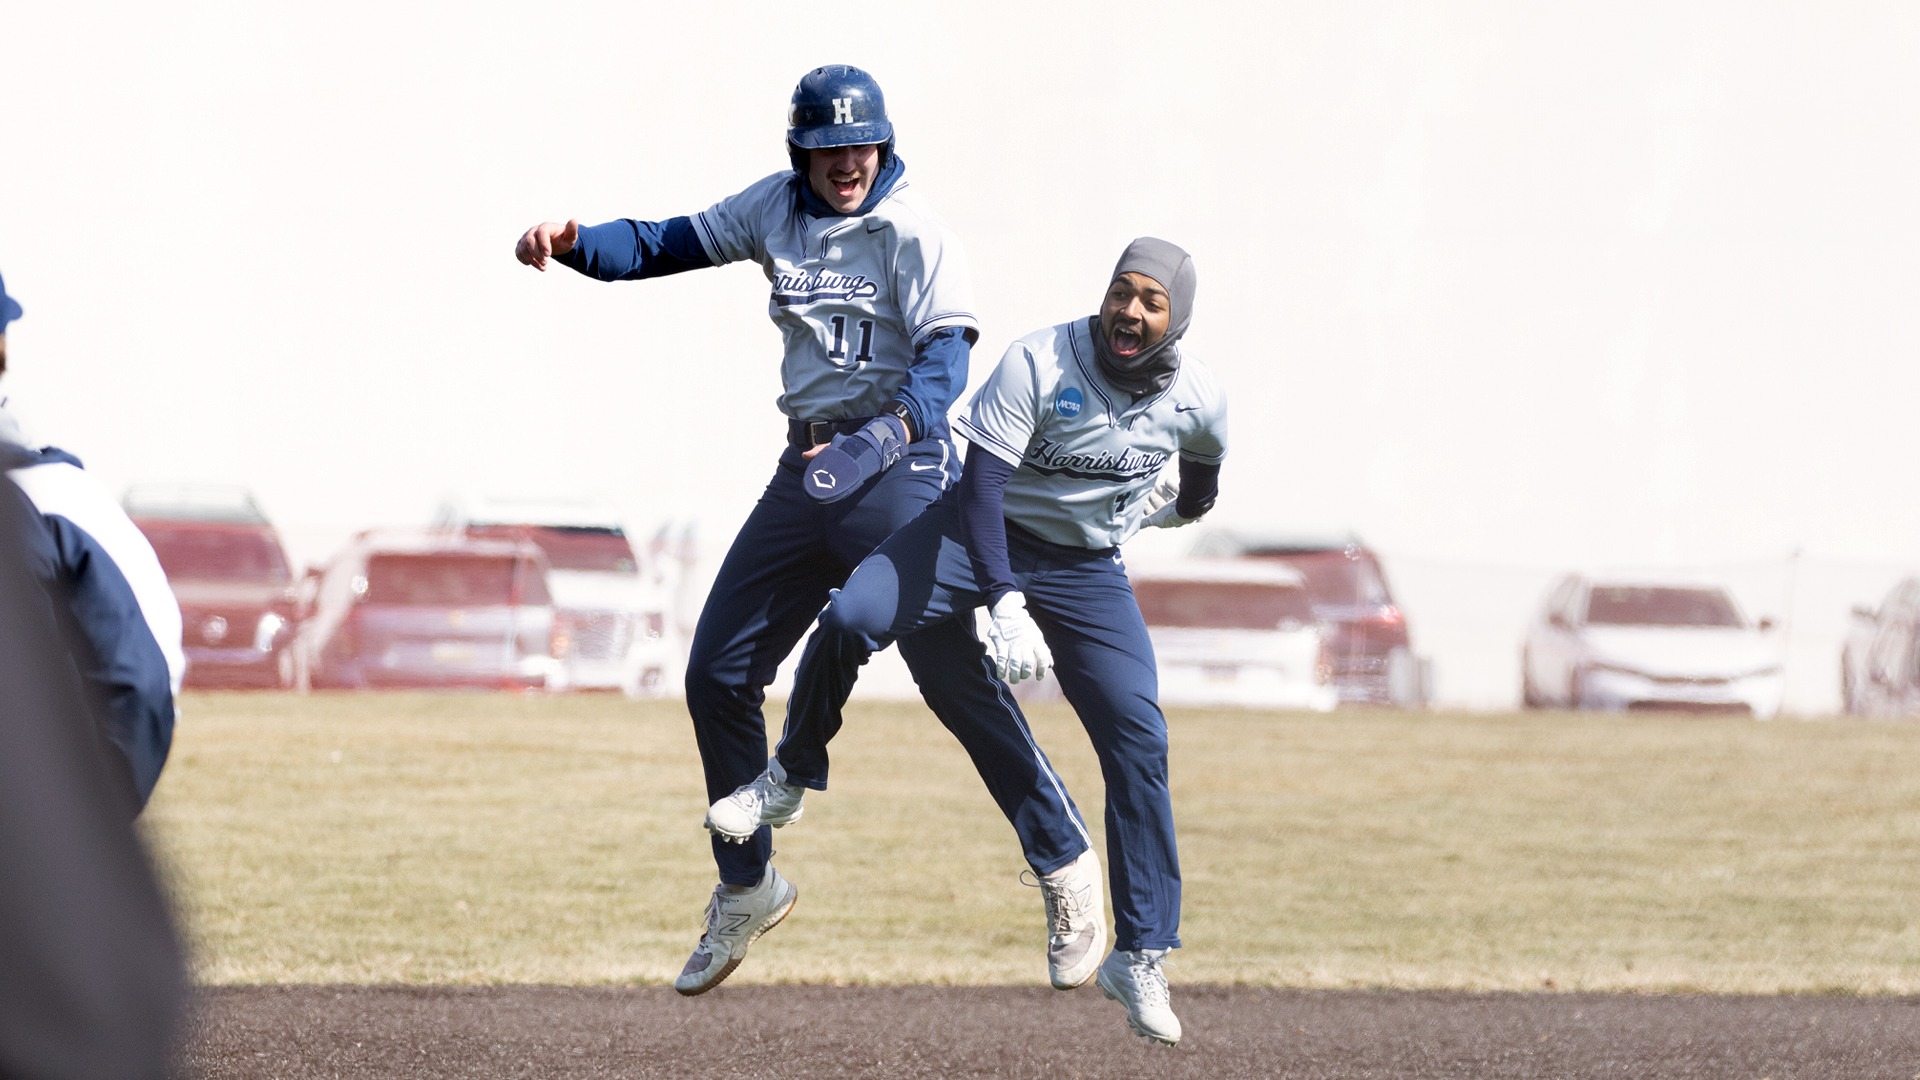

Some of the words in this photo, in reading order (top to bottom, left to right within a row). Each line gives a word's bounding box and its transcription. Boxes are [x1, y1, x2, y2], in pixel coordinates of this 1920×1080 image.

[832, 98, 854, 124] H
[827, 314, 876, 362] 11
[1058, 399, 1080, 412] NCAA
[1029, 437, 1168, 480] Harrisburg
